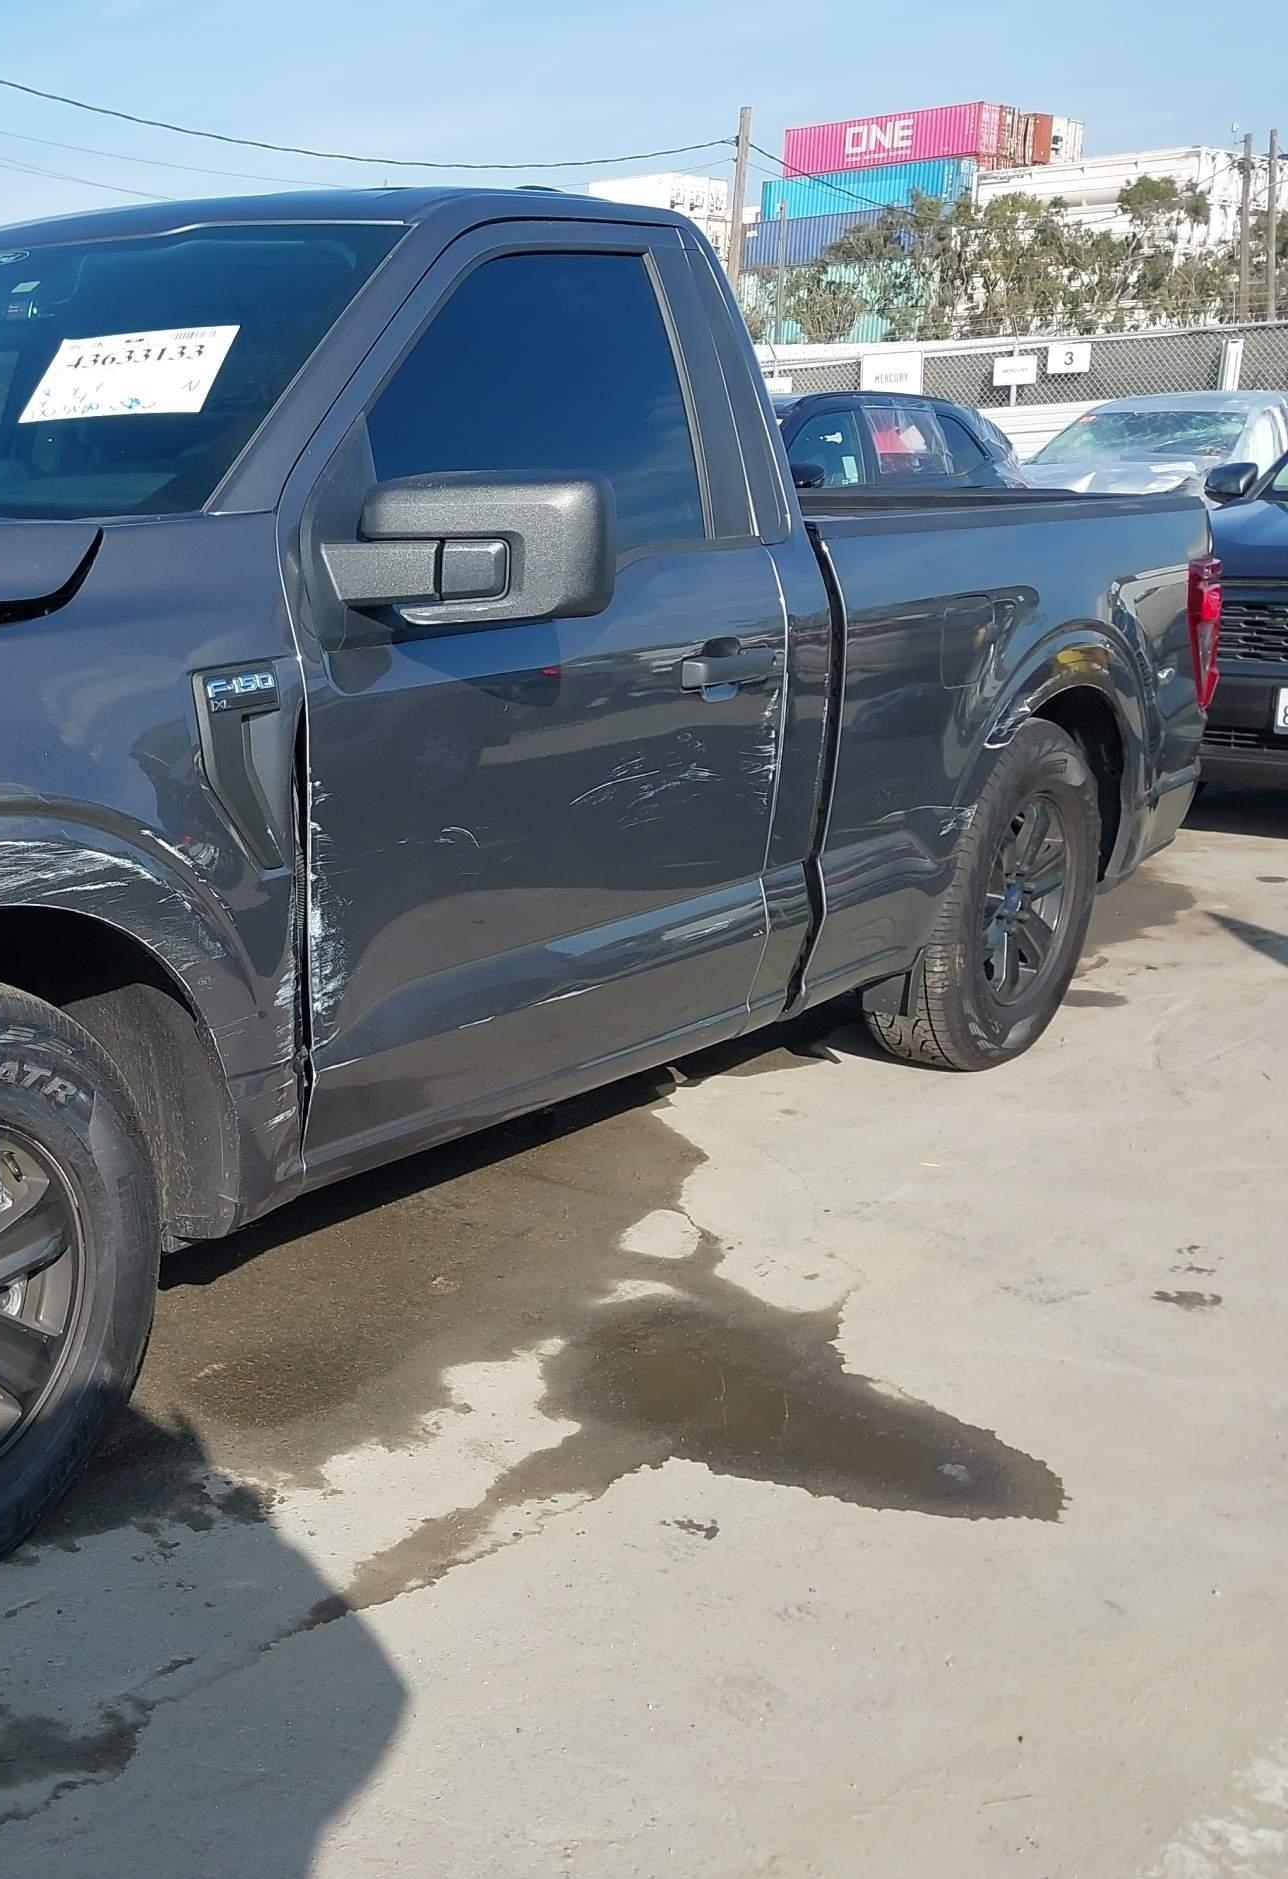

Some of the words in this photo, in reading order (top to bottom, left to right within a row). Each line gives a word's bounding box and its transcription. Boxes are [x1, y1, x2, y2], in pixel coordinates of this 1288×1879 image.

[845, 118, 914, 154] ONE
[1064, 351, 1074, 366] 3
[874, 372, 910, 384] MERCURY
[206, 671, 276, 699] F-150
